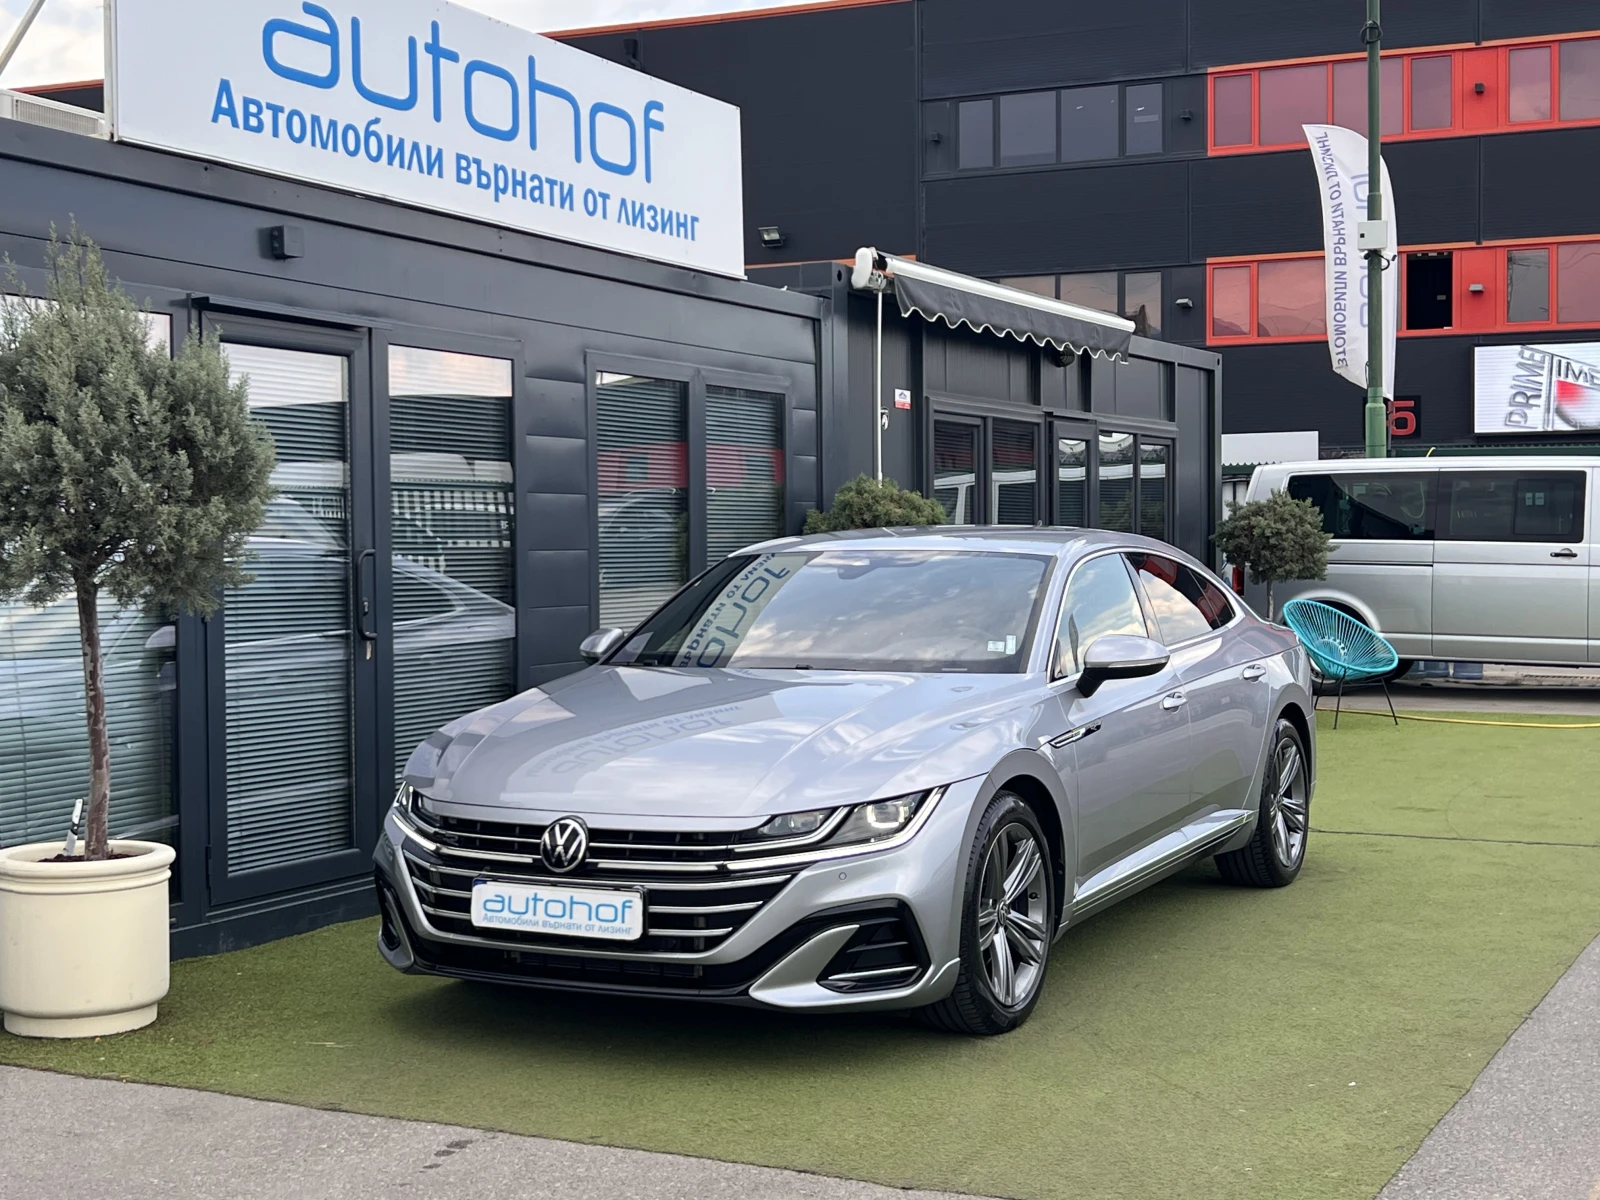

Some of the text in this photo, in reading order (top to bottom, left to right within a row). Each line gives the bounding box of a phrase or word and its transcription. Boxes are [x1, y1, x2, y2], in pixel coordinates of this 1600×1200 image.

[262, 1, 664, 184] autohof
[211, 78, 699, 241] Автомобили върнати от лизинг
[1504, 347, 1546, 429] PRIME
[482, 893, 633, 924] autohof
[482, 913, 633, 936] Автомобили върнати от лизинг
